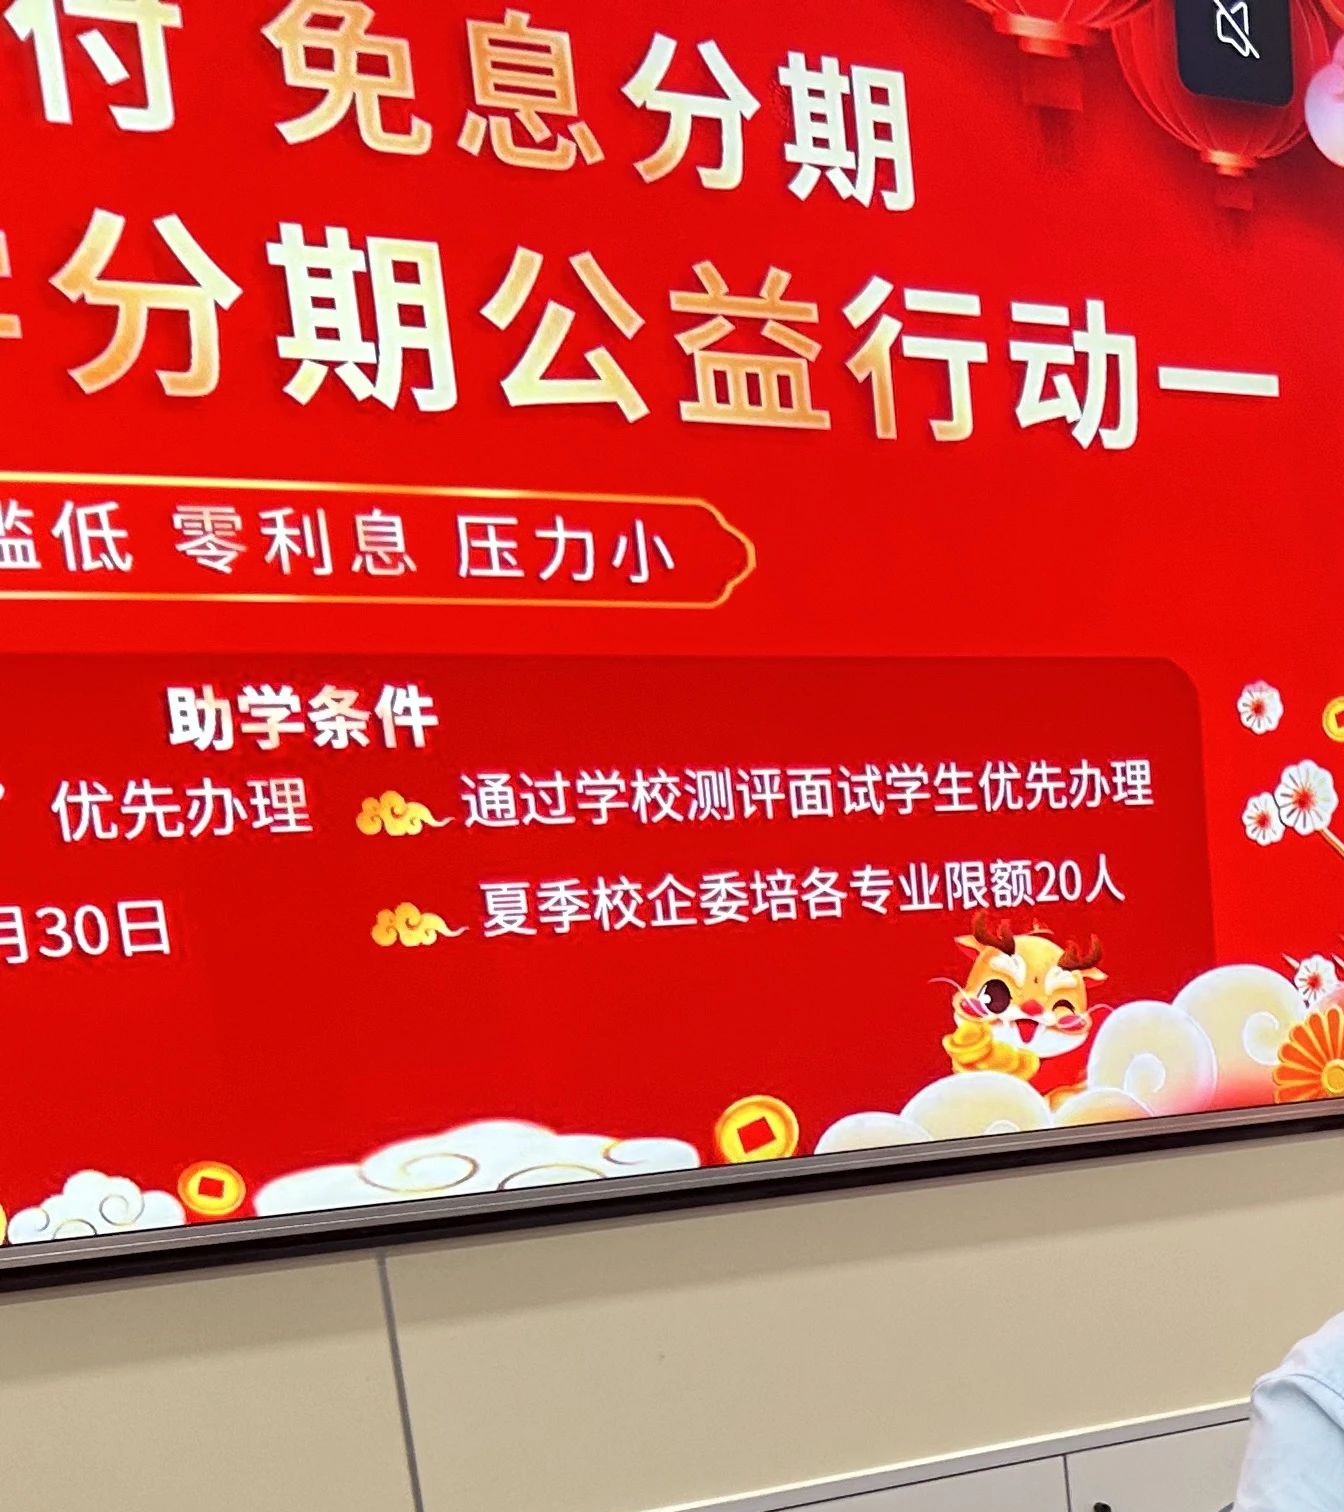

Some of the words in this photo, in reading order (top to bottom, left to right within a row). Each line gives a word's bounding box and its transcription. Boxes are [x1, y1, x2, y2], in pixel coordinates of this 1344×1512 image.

[261, 0, 917, 212] 免息分期
[171, 505, 419, 578] 零利息
[456, 515, 675, 584] 压力小
[165, 683, 440, 751] 助学条件
[51, 777, 313, 843] 优先办理
[458, 757, 1155, 829] 通过学校测评面试学生优先办理
[478, 853, 1127, 939] 夏季校企委培各专业限额20人
